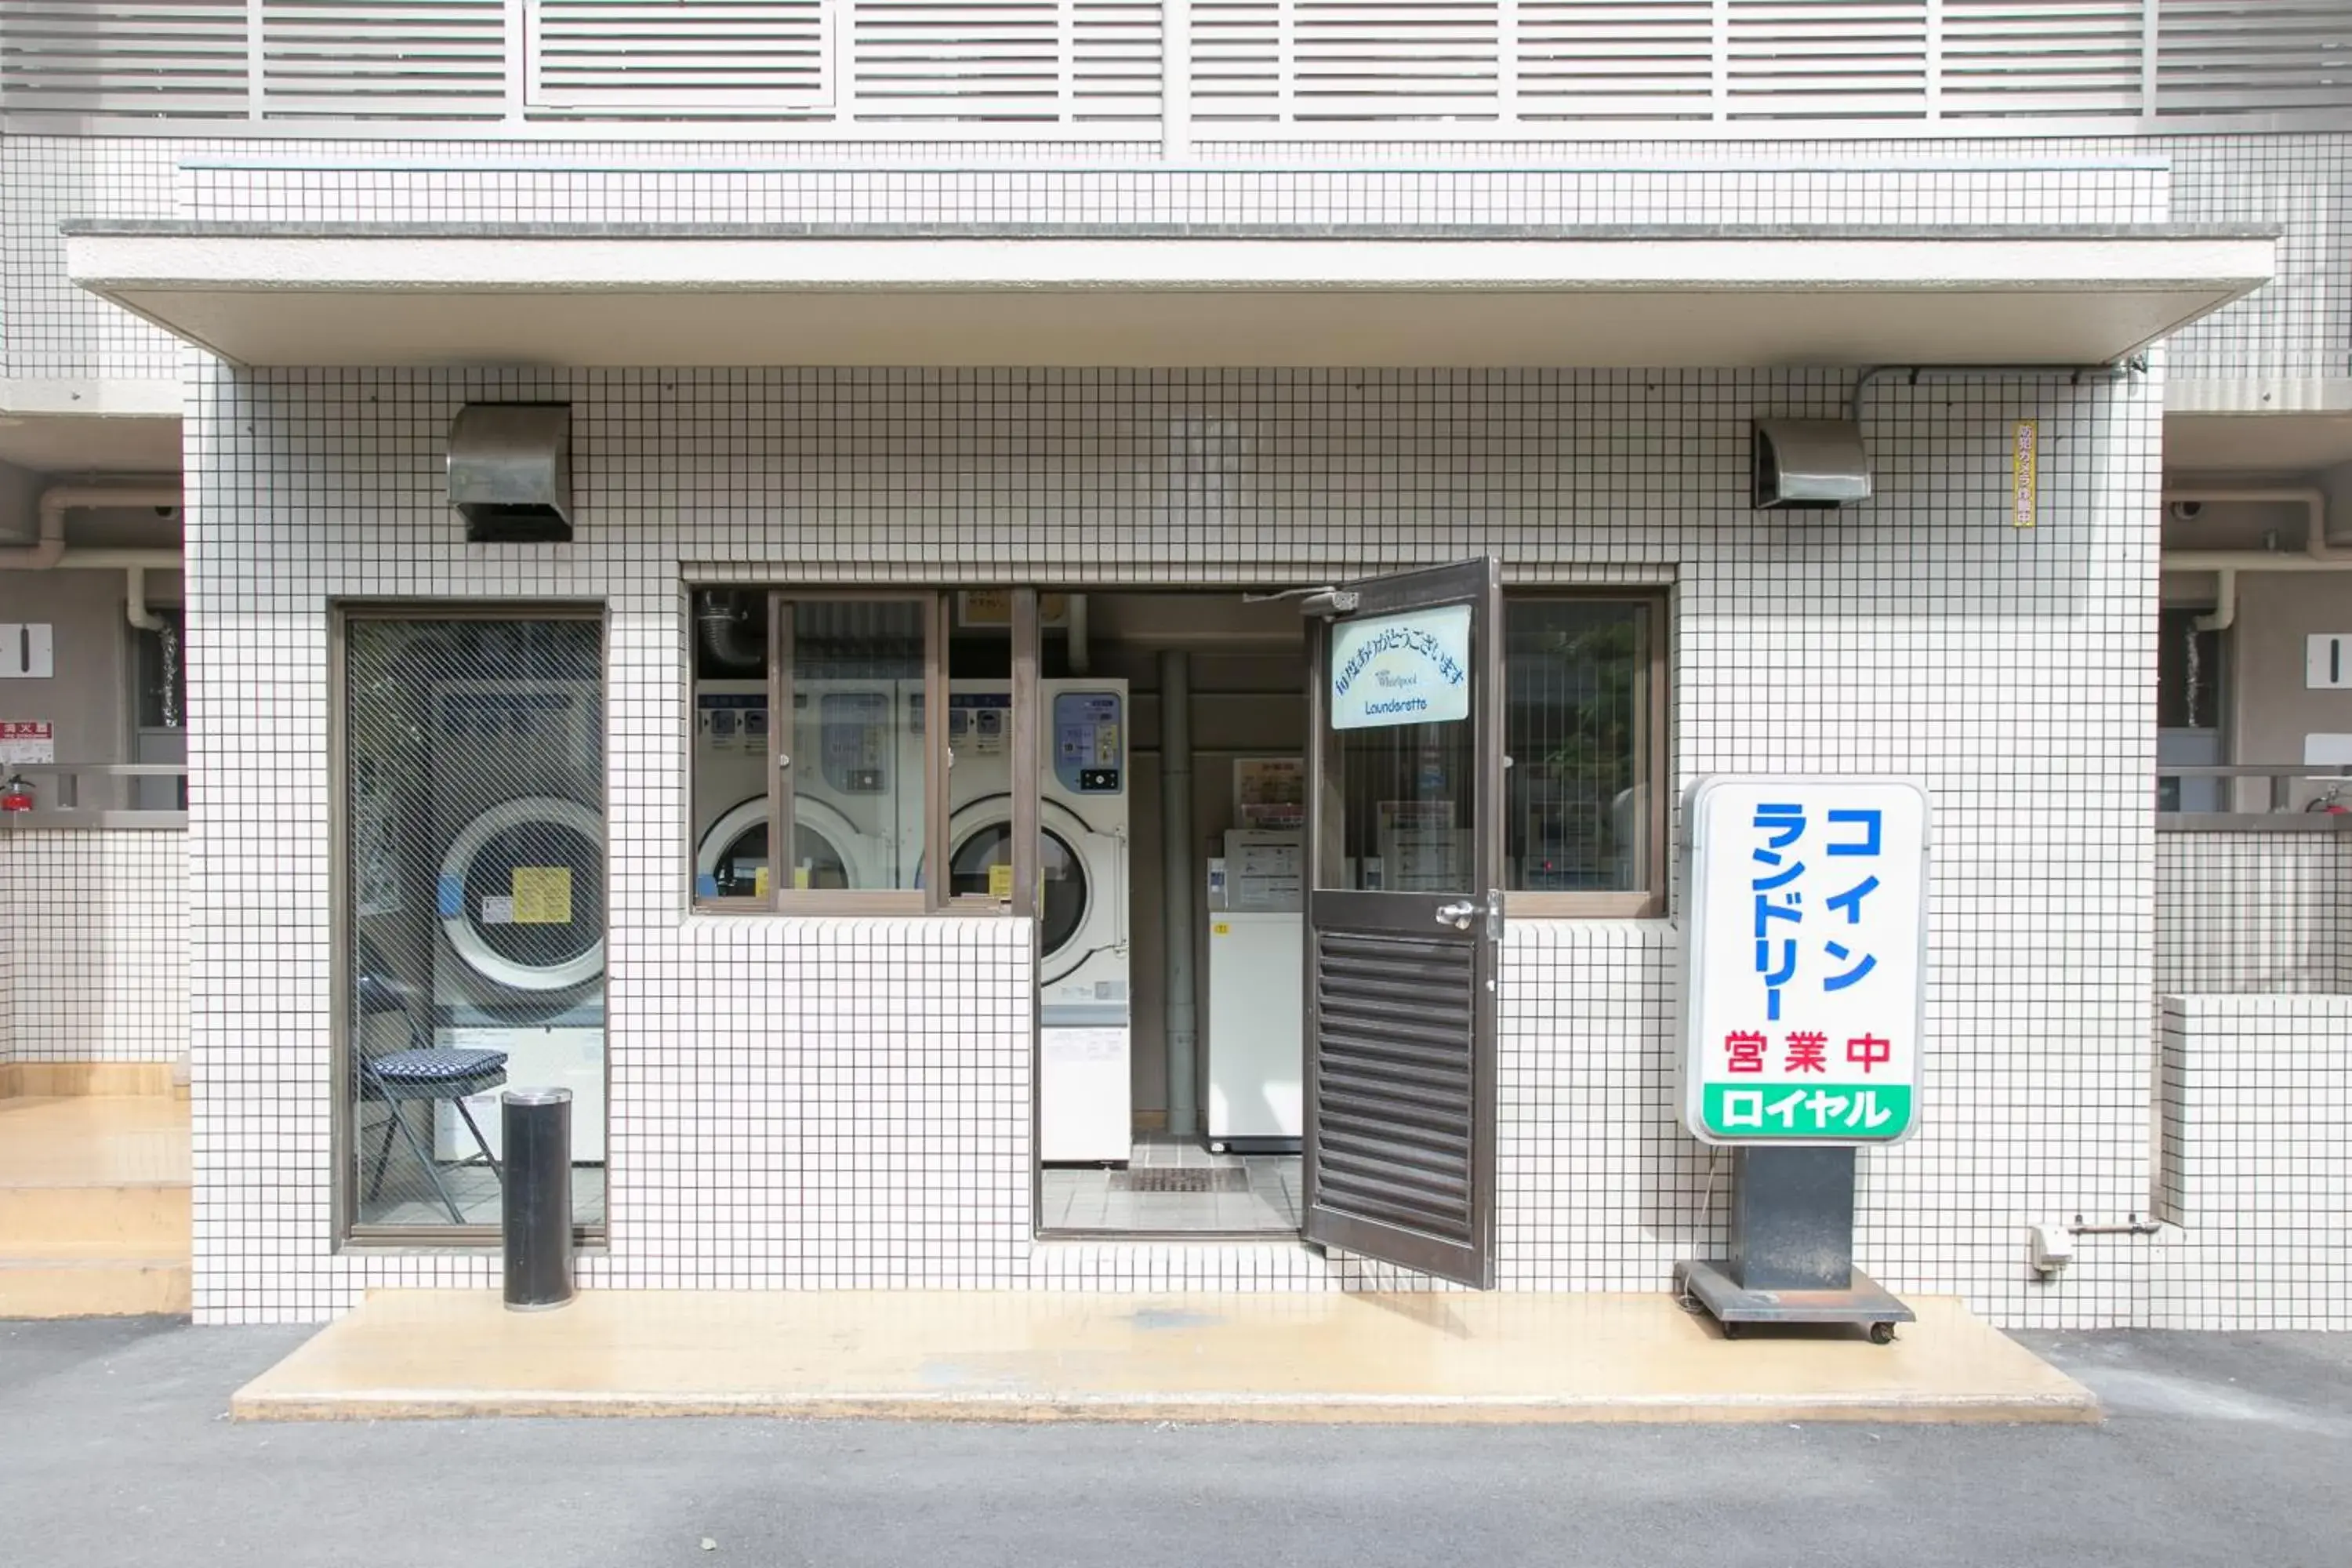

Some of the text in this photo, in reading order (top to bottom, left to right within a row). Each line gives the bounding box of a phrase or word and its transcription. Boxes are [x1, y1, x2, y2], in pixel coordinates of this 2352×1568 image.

[1335, 627, 1465, 695] 毎度ありがとうございます
[1365, 698, 1428, 715] Launderette
[1752, 804, 1806, 1020] ランドリー
[1824, 810, 1882, 991] コイン
[1725, 1030, 1891, 1074] 営業中
[1722, 1090, 1892, 1128] ロイヤル
